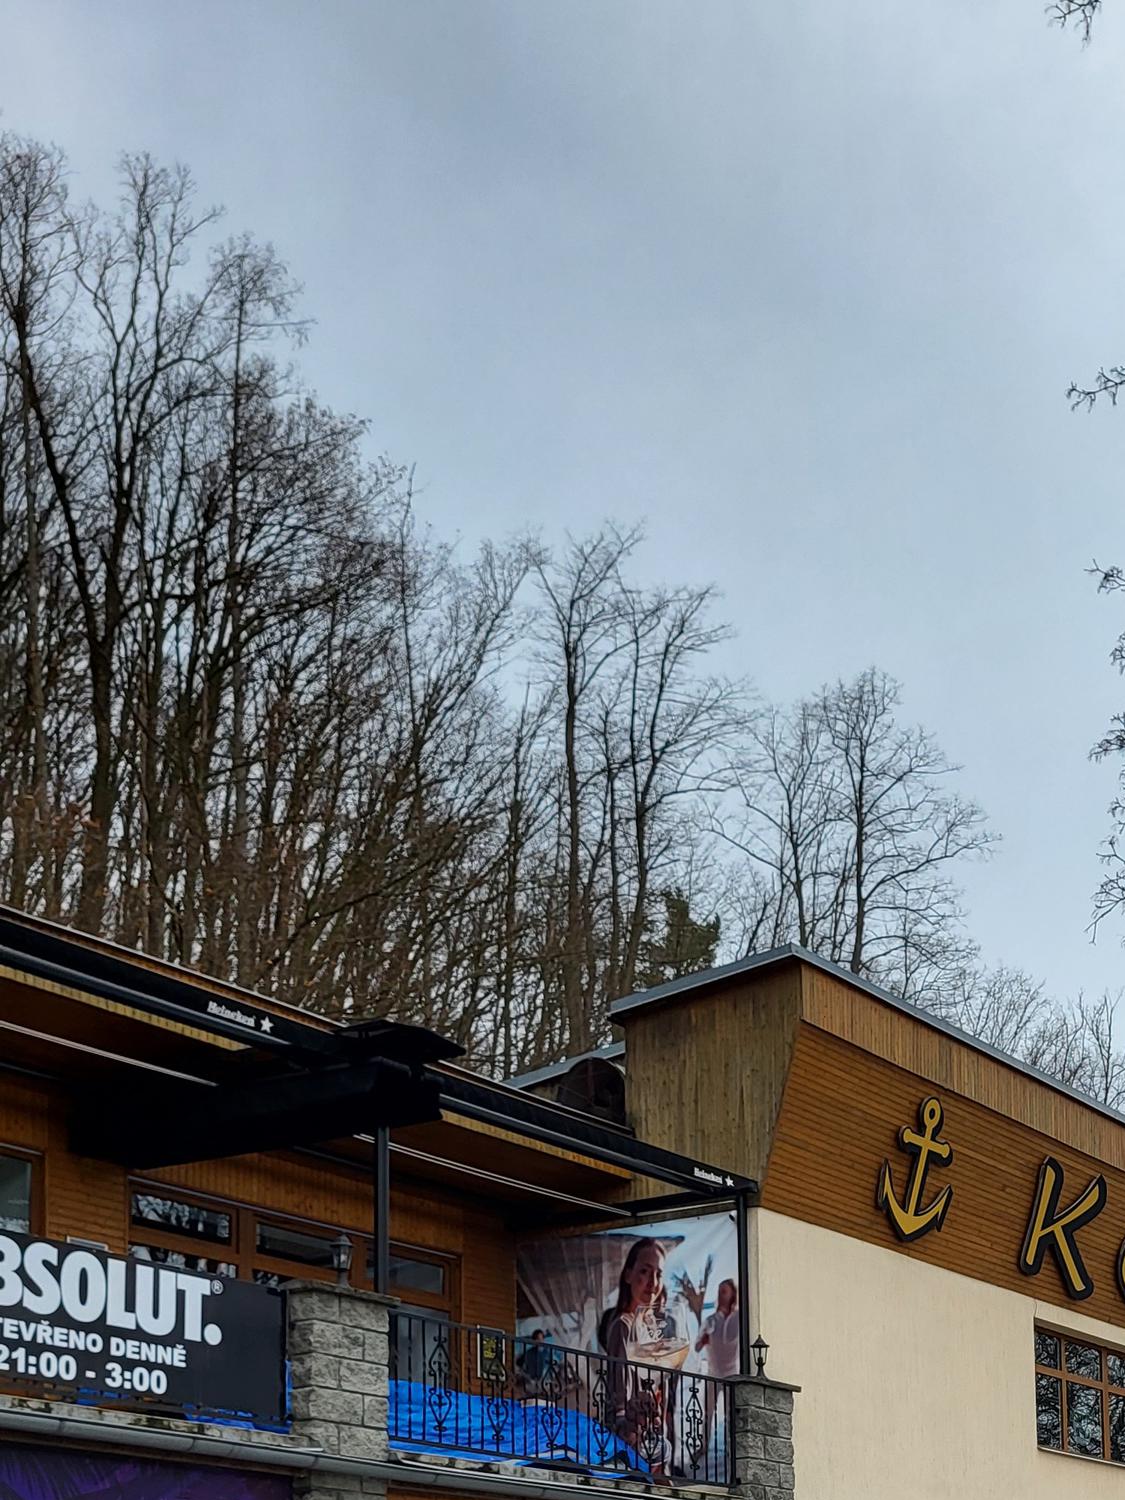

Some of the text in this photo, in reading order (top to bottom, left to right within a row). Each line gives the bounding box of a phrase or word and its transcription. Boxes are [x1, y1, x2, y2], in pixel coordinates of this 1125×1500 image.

[0, 1317, 187, 1367] EVŘENO DENNĚ
[104, 1362, 168, 1395] 3:00
